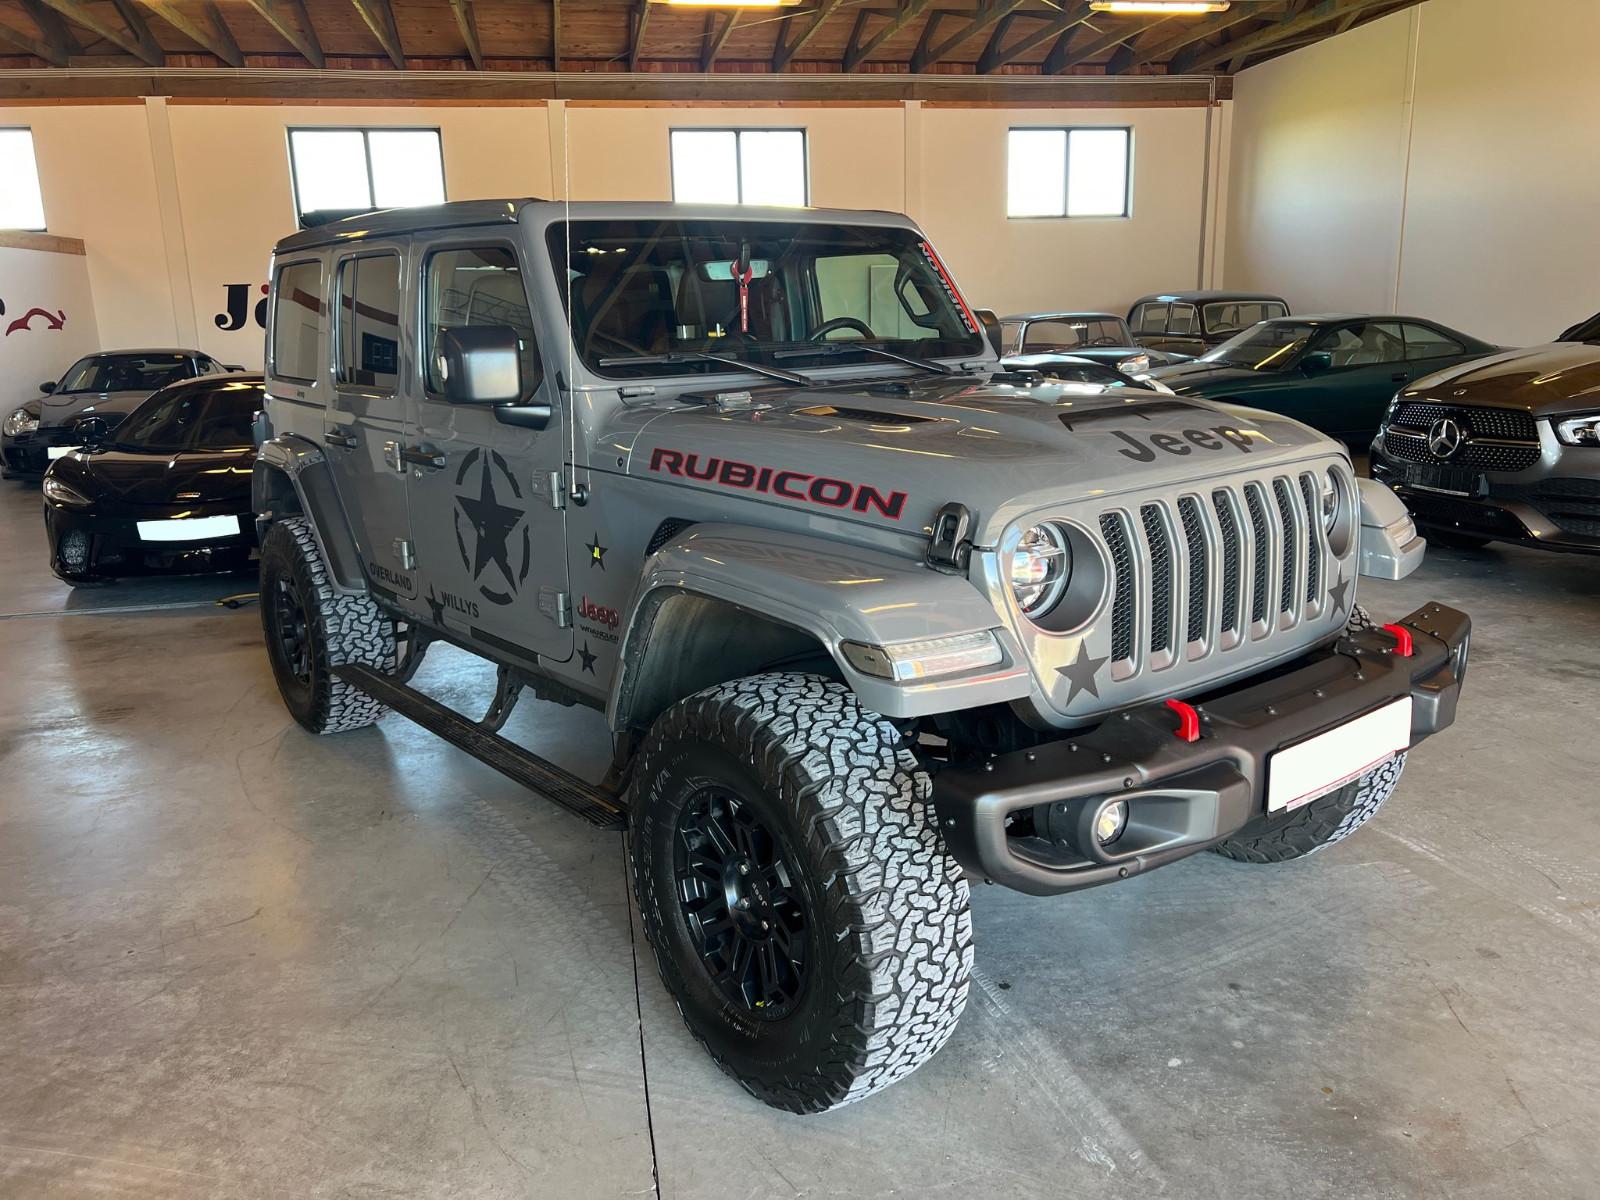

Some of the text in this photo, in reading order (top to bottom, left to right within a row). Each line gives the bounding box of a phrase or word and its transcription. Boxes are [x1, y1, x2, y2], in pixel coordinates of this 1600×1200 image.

[917, 242, 976, 334] RUBICON
[1110, 425, 1254, 463] Jeep
[649, 447, 909, 521] RUBICON
[369, 562, 412, 591] OVERLAND
[441, 591, 480, 619] WILLYS
[577, 594, 619, 631] Jeep
